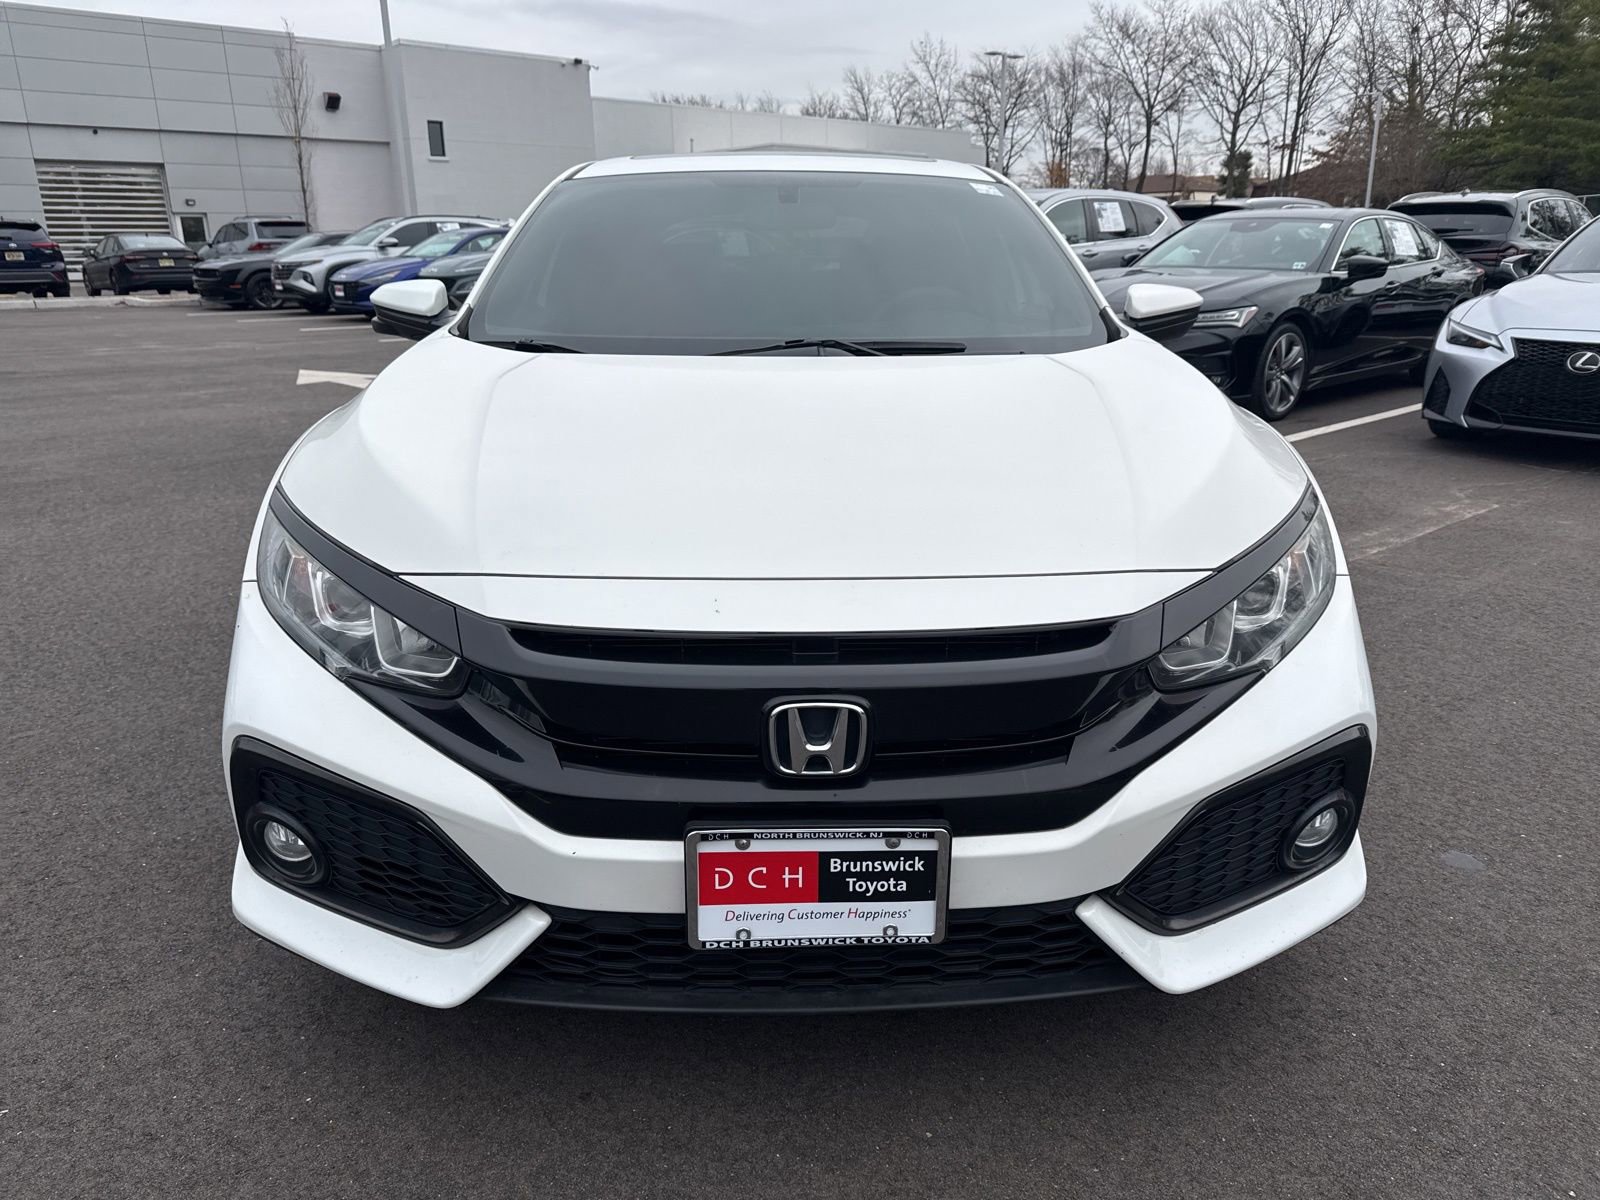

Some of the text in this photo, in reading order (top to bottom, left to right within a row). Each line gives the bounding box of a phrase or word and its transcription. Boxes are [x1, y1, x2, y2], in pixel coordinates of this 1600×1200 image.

[829, 856, 925, 873] Brunswick
[845, 877, 907, 896] Toyota
[724, 910, 785, 923] Delivering
[787, 908, 845, 919] Customer
[705, 936, 930, 949] DCH BRUNSWICK TOYOTA
